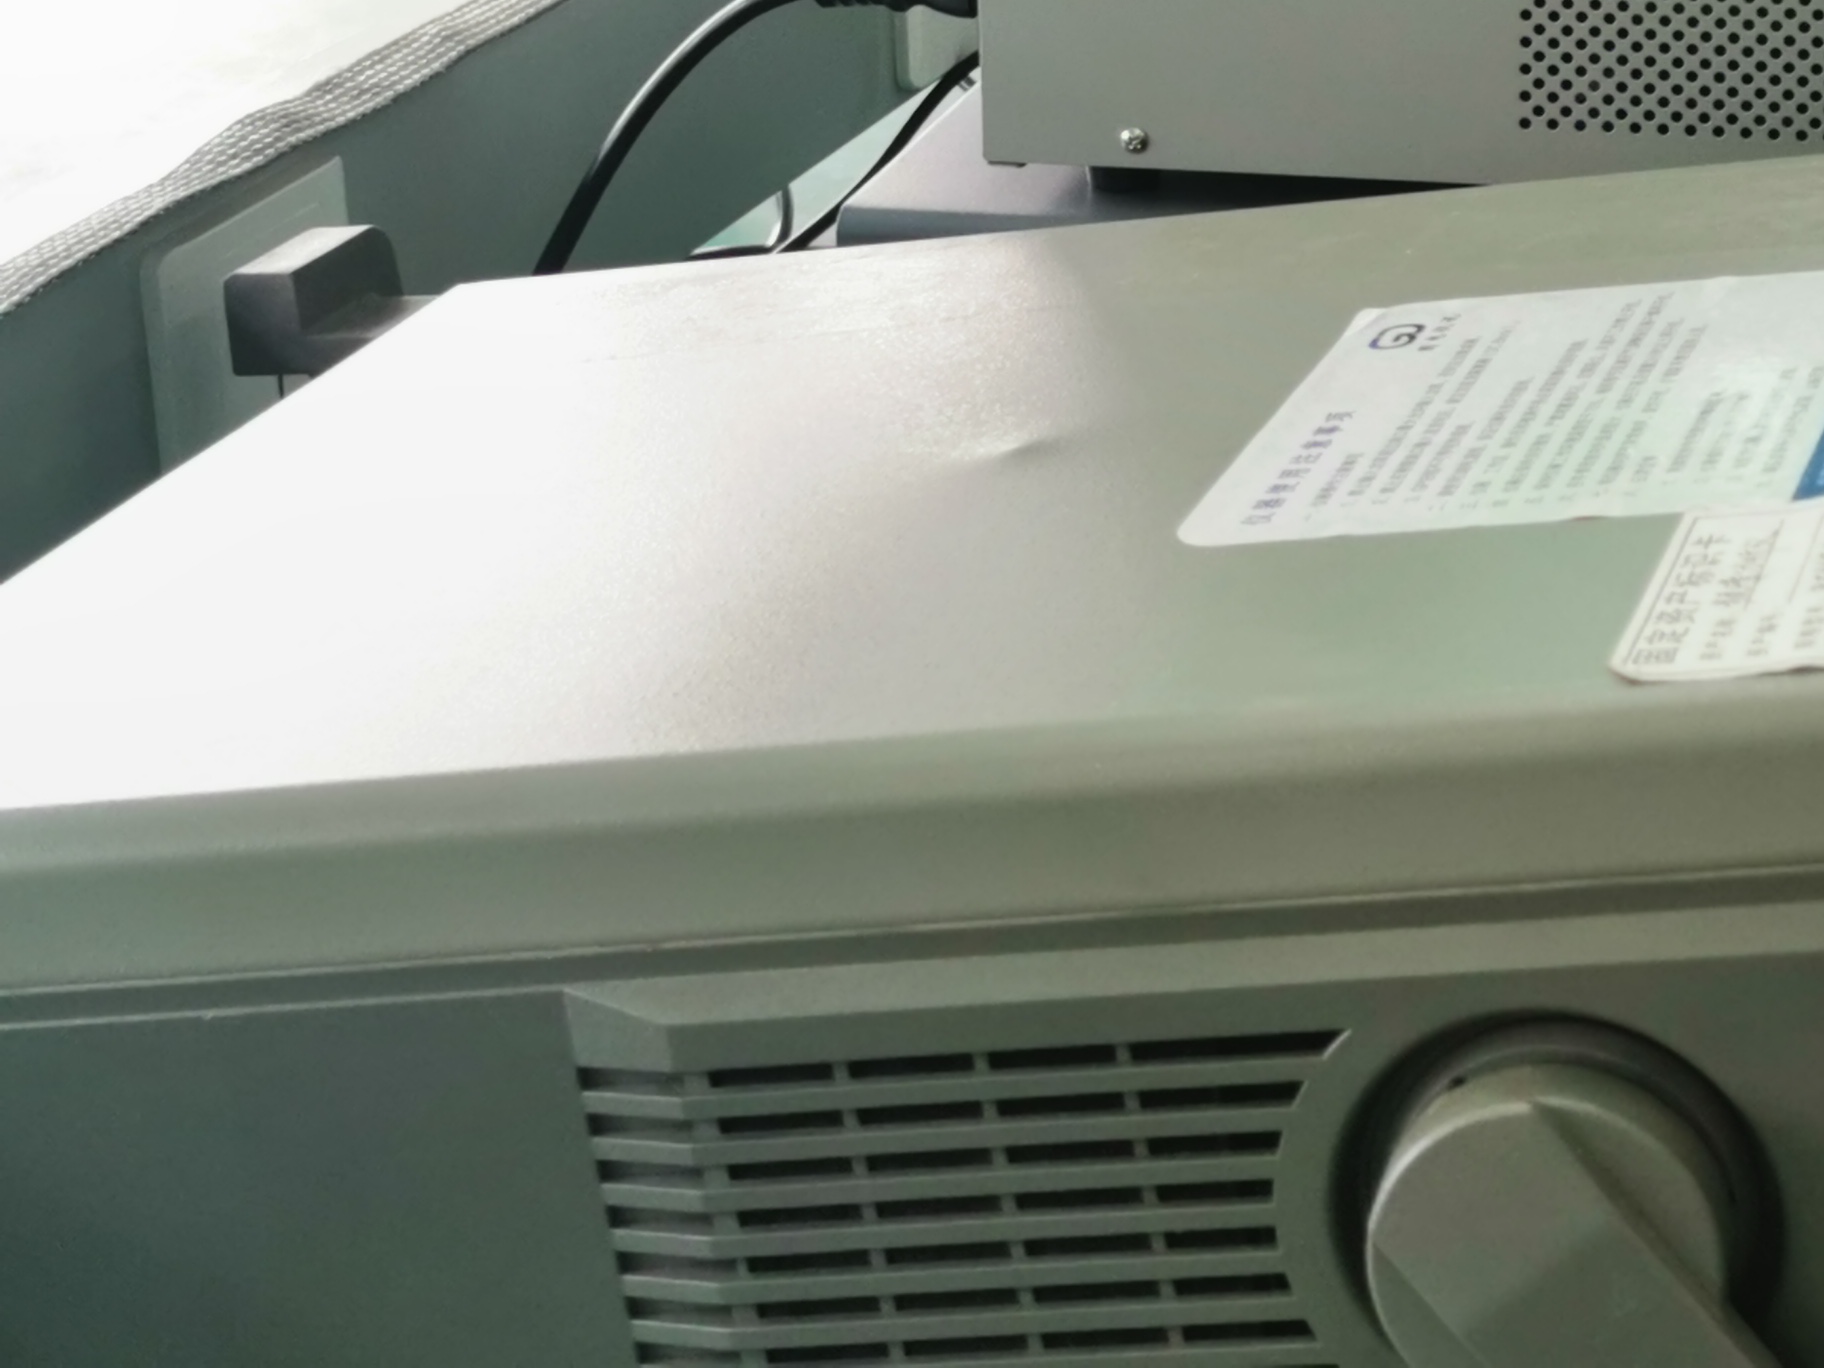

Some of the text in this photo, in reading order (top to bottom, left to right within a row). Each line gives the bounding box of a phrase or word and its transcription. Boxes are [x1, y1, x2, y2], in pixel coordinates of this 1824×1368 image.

[1240, 411, 1354, 525] 仪器使用注意事项
